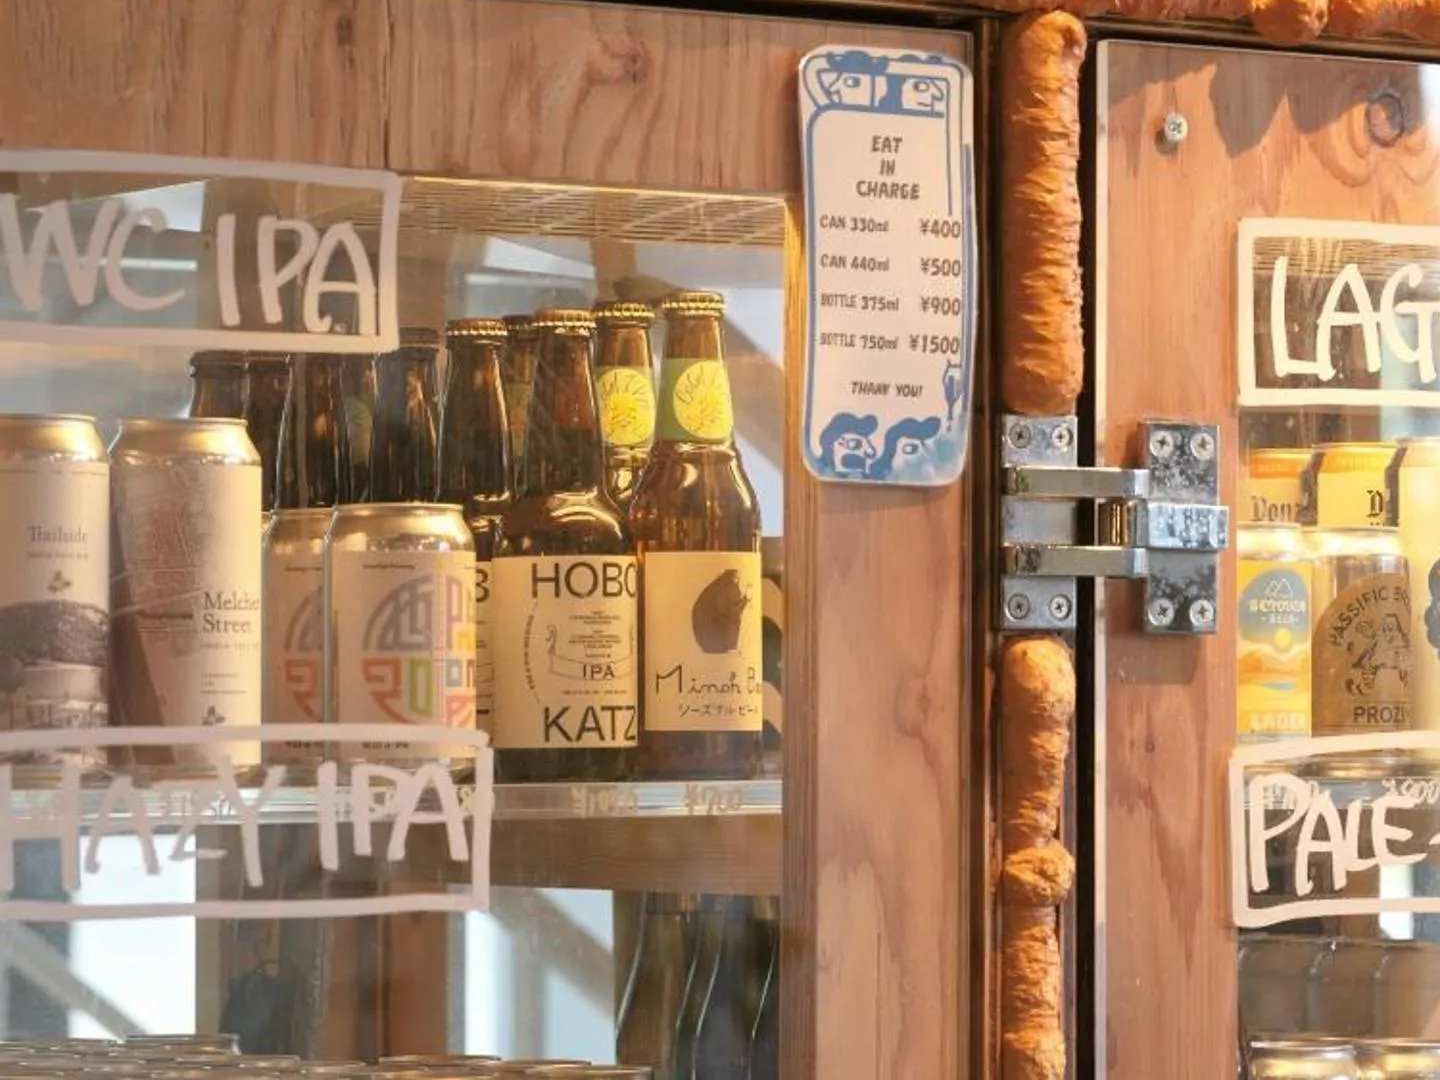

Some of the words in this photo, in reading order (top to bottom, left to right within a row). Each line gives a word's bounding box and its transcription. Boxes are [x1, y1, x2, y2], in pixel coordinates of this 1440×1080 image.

[871, 135, 903, 154] EAT
[879, 159, 896, 176] IN
[856, 180, 920, 200] CHARGE
[820, 214, 846, 229] CAN
[850, 217, 889, 232] 330ml
[920, 218, 961, 239] ¥400
[216, 214, 378, 335] IPA
[820, 253, 847, 269] CAN
[851, 255, 890, 272] 440ml
[920, 257, 961, 278] ¥500
[820, 293, 857, 309] BOTTLE
[861, 296, 900, 312] 375ml
[920, 296, 961, 316] ¥900
[820, 332, 857, 348] BOTTLE
[860, 334, 899, 351] 750ml
[909, 333, 960, 355] ¥1500
[851, 381, 890, 396] THANK
[582, 663, 616, 681] IPA
[655, 664, 742, 696] Minoh
[543, 705, 637, 744] KATZ
[318, 760, 470, 871] IPA
[1249, 773, 1428, 896] PALE
